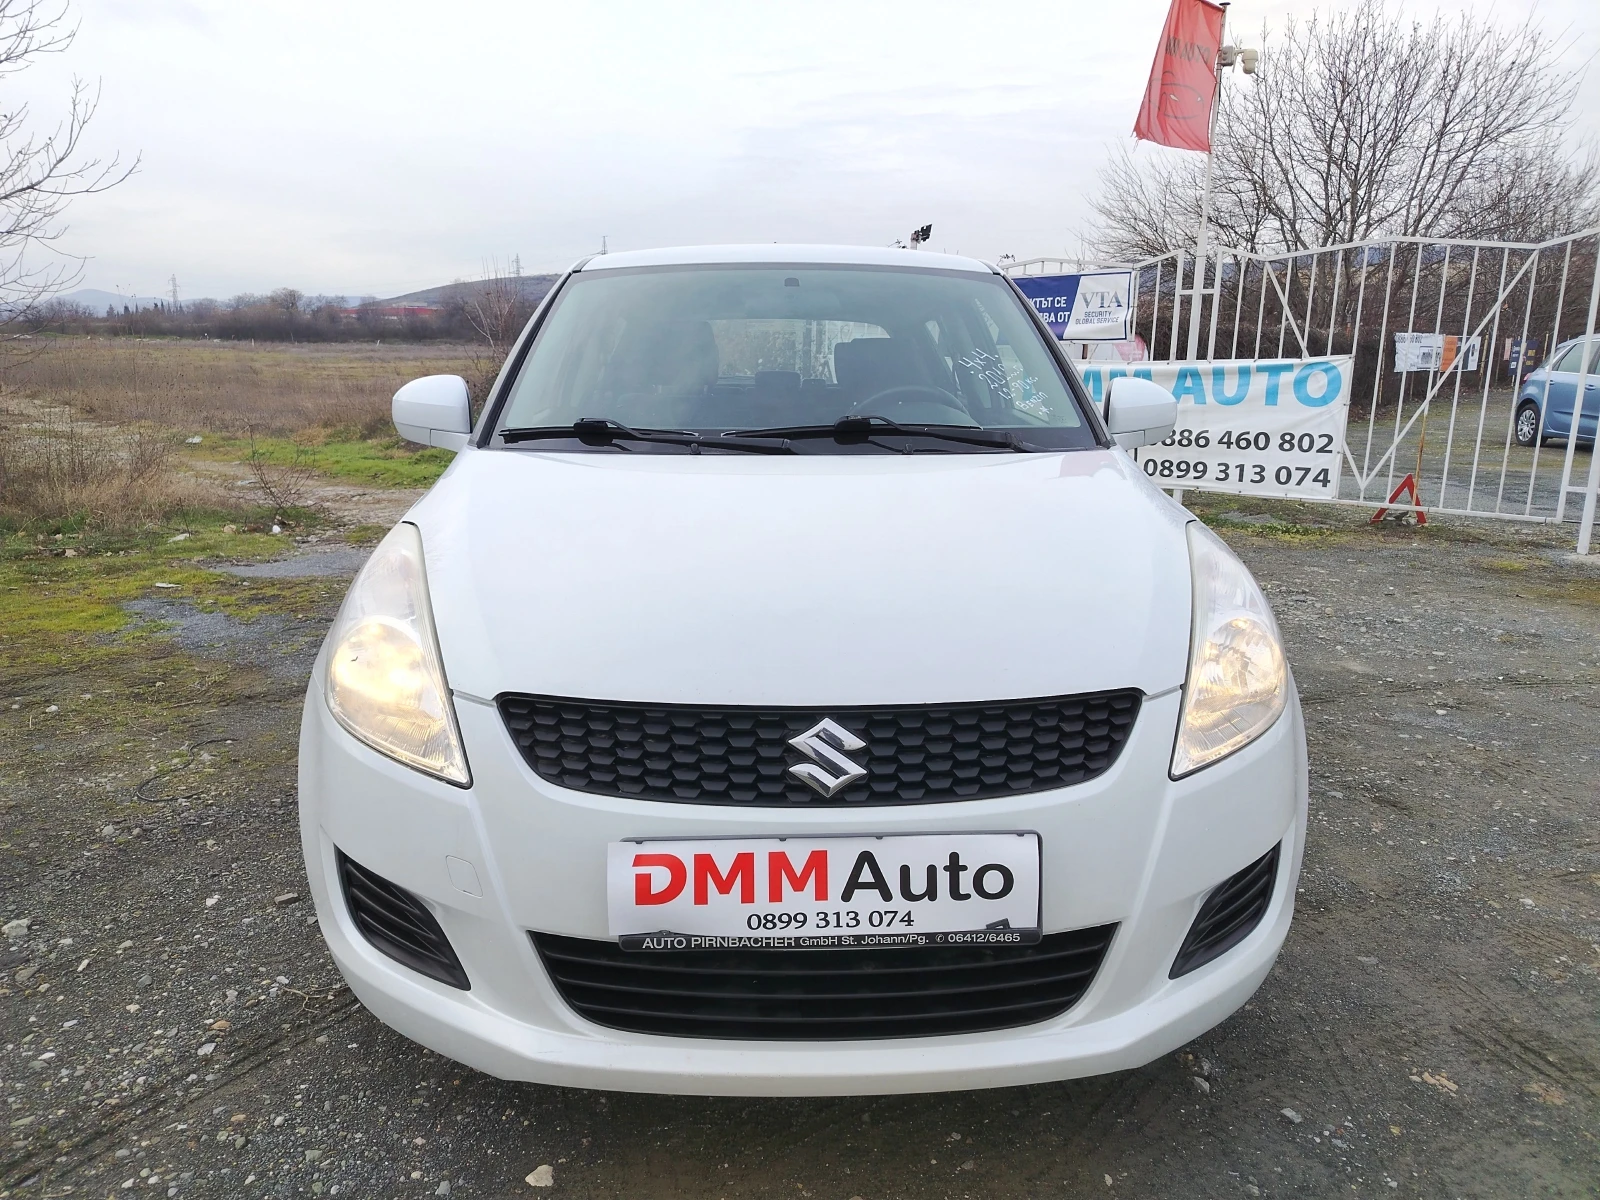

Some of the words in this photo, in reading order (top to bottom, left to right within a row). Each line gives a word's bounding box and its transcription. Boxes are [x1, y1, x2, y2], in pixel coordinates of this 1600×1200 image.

[1054, 296, 1067, 308] СЕ
[1081, 291, 1123, 309] VTA
[1057, 311, 1070, 322] ОТ
[1075, 317, 1096, 325] GLOBAL
[1096, 316, 1120, 324] SERVICE
[1172, 361, 1343, 408] AUTO
[1149, 428, 1210, 449] 886
[1217, 430, 1271, 452] 460
[1278, 432, 1334, 454] 802
[1143, 458, 1208, 480] 0899
[1215, 462, 1266, 484] 313
[1274, 466, 1331, 488] 074
[746, 911, 808, 932] 0899
[815, 910, 861, 930] 313
[868, 909, 915, 928] 074
[642, 937, 687, 949] AUTO
[691, 936, 795, 949] PIRNBACHER
[799, 936, 838, 946] GmbH
[841, 935, 858, 945] St.
[861, 934, 929, 945] Johann/Pg.
[947, 933, 1020, 943] 06412/6465
